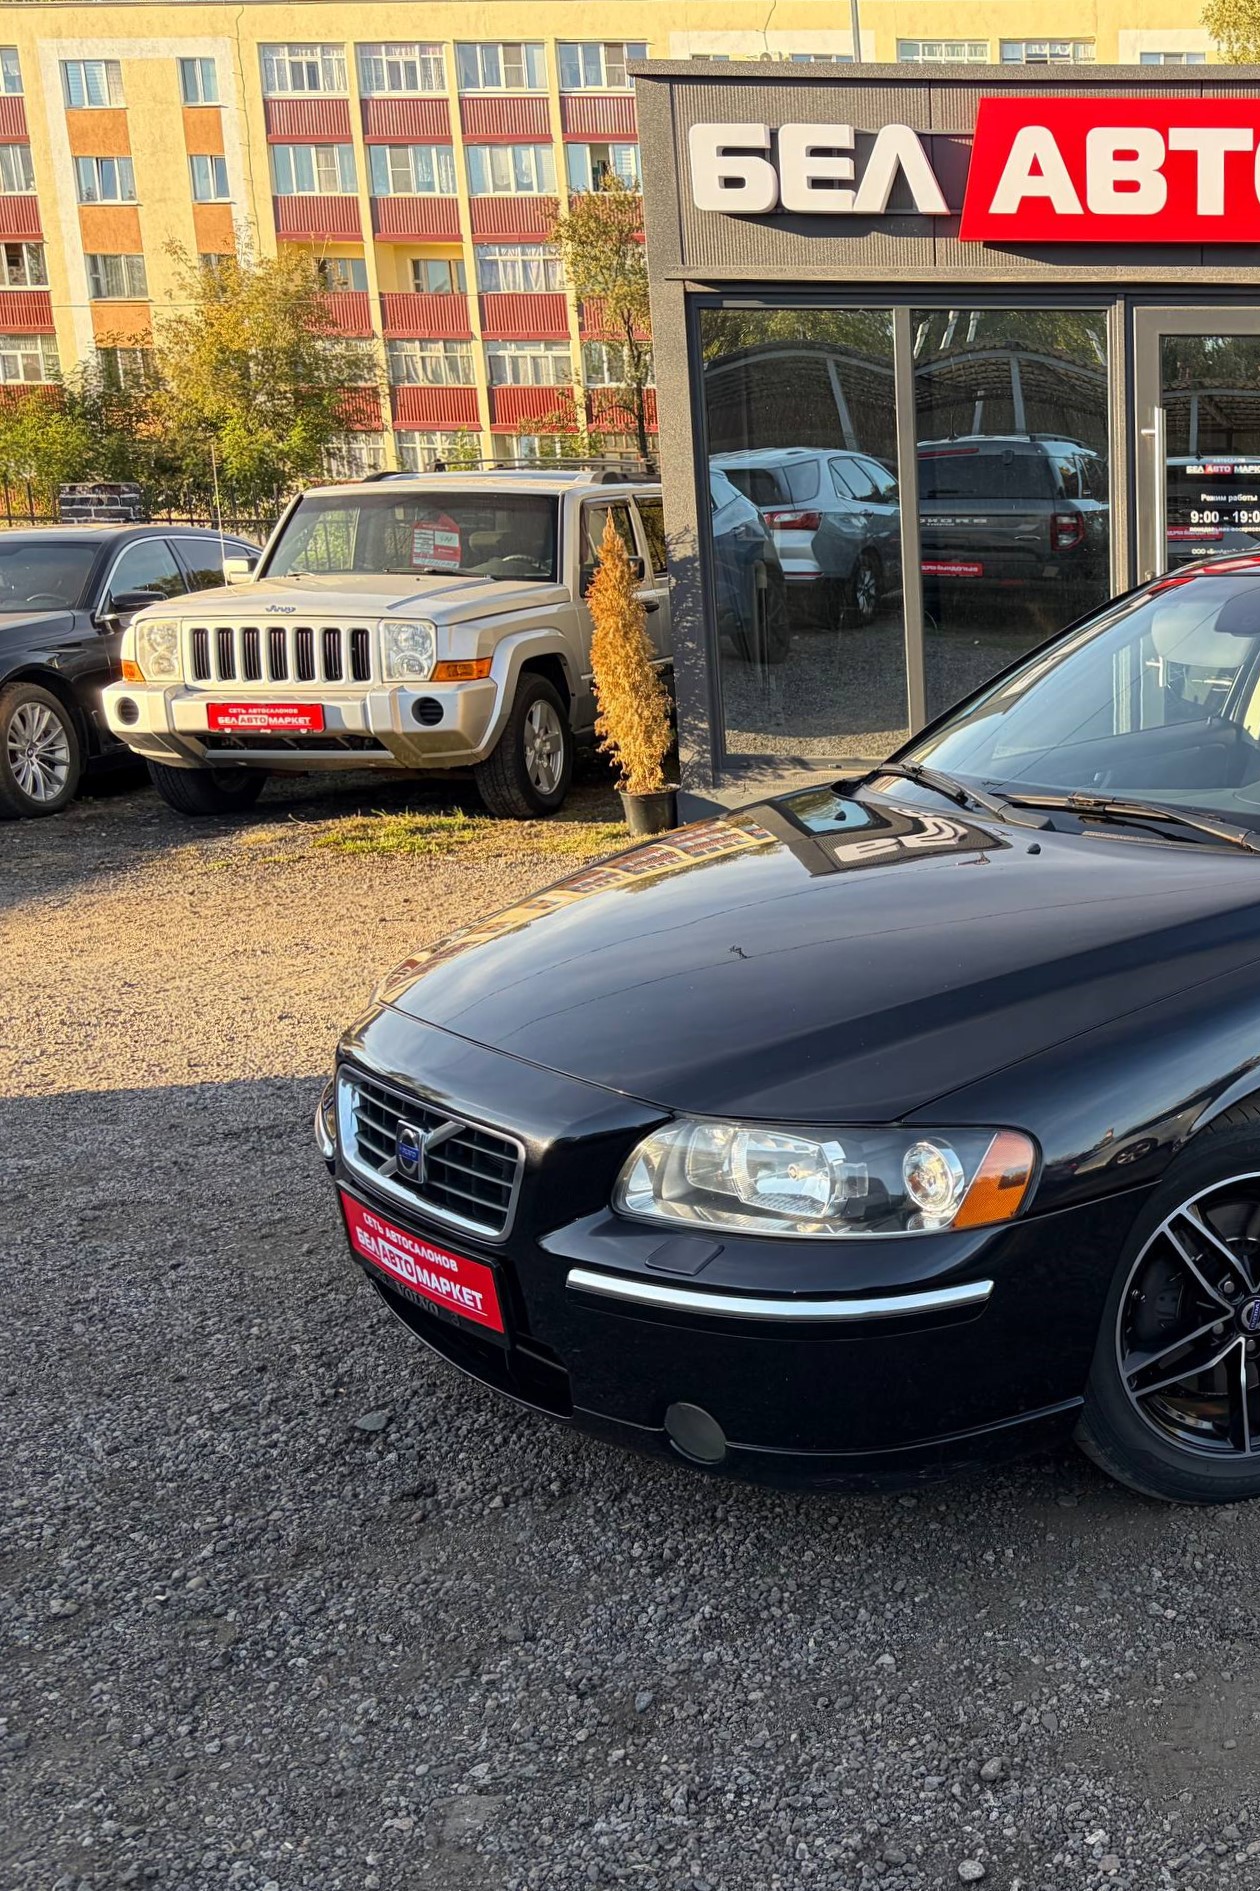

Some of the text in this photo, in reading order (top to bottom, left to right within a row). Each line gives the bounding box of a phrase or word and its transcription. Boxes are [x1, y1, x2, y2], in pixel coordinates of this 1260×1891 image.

[688, 122, 950, 214] БЕЛ
[1201, 493, 1258, 502] Режим работы
[1190, 510, 1219, 523] 9:00
[218, 716, 311, 724] БЕЛ АВТО МАРКЕТ
[362, 1212, 458, 1272] СЕТЬ АВТОСАЛОНОВ
[355, 1226, 483, 1310] БЕЛ АВТО МАРКЕТ
